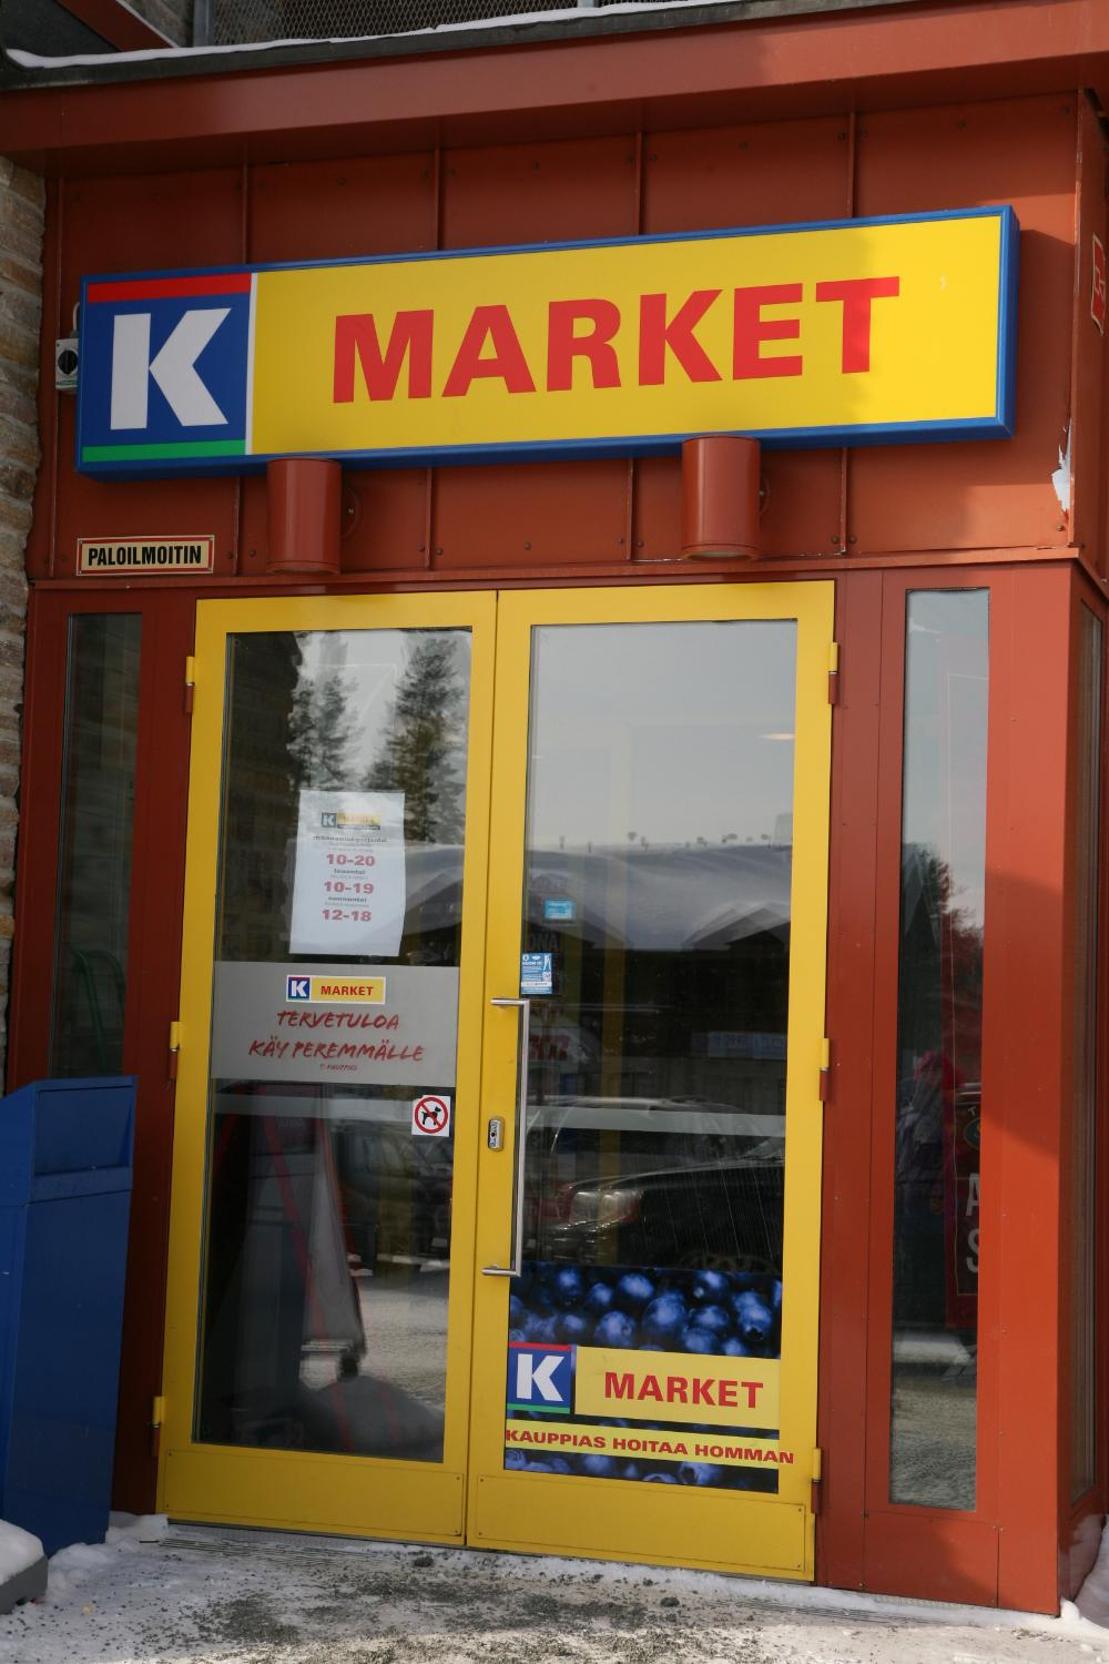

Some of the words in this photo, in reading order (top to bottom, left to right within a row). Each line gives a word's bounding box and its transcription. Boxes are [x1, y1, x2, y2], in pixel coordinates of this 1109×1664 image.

[110, 308, 231, 430] K
[333, 276, 900, 403] MARKET
[88, 545, 202, 566] PALOILMOITIN
[326, 853, 376, 867] 10-20
[324, 881, 374, 894] 10-19
[322, 909, 372, 922] 12-18
[290, 979, 308, 998] K
[320, 984, 374, 997] MARKET
[277, 1010, 400, 1030] TERVETULOA
[248, 1034, 290, 1059] KÄY
[292, 1037, 424, 1062] PEREMMÄLLE
[516, 1353, 565, 1402] K
[604, 1371, 764, 1410] MARKET
[505, 1429, 606, 1449] KAUPPIAS
[612, 1437, 688, 1456] HOITAA
[694, 1444, 794, 1465] HOMMAN
